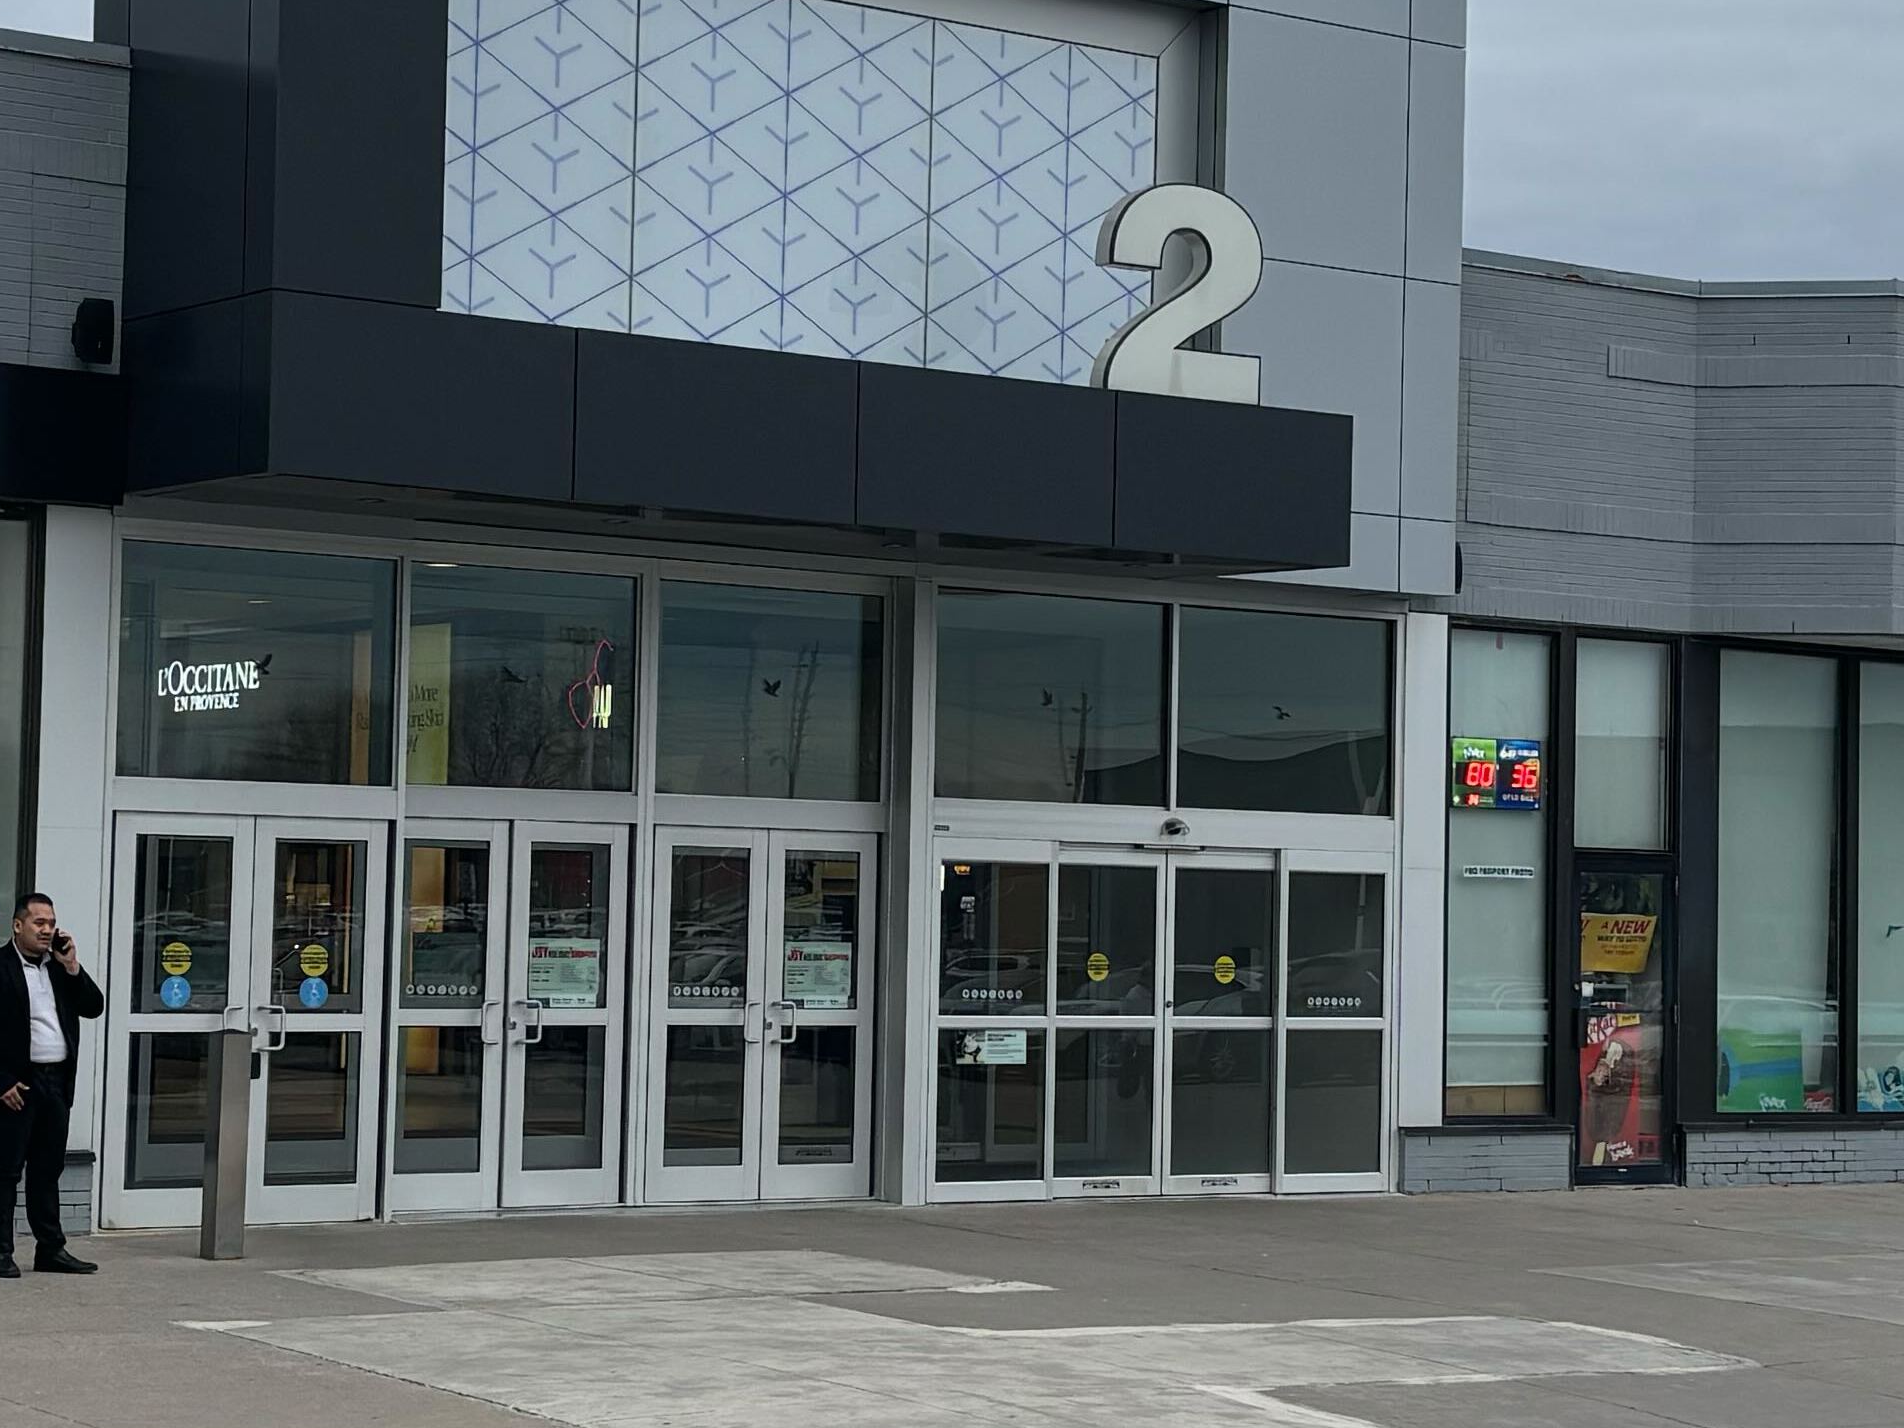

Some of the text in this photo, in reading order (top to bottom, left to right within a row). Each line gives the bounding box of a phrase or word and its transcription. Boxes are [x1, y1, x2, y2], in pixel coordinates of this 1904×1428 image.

[1091, 182, 1263, 406] 2
[158, 660, 260, 696] L'OCCITANE
[174, 692, 240, 712] EN PROVENCE
[1466, 762, 1495, 787] 80
[1512, 764, 1537, 789] 36
[1610, 919, 1652, 935] NEW
